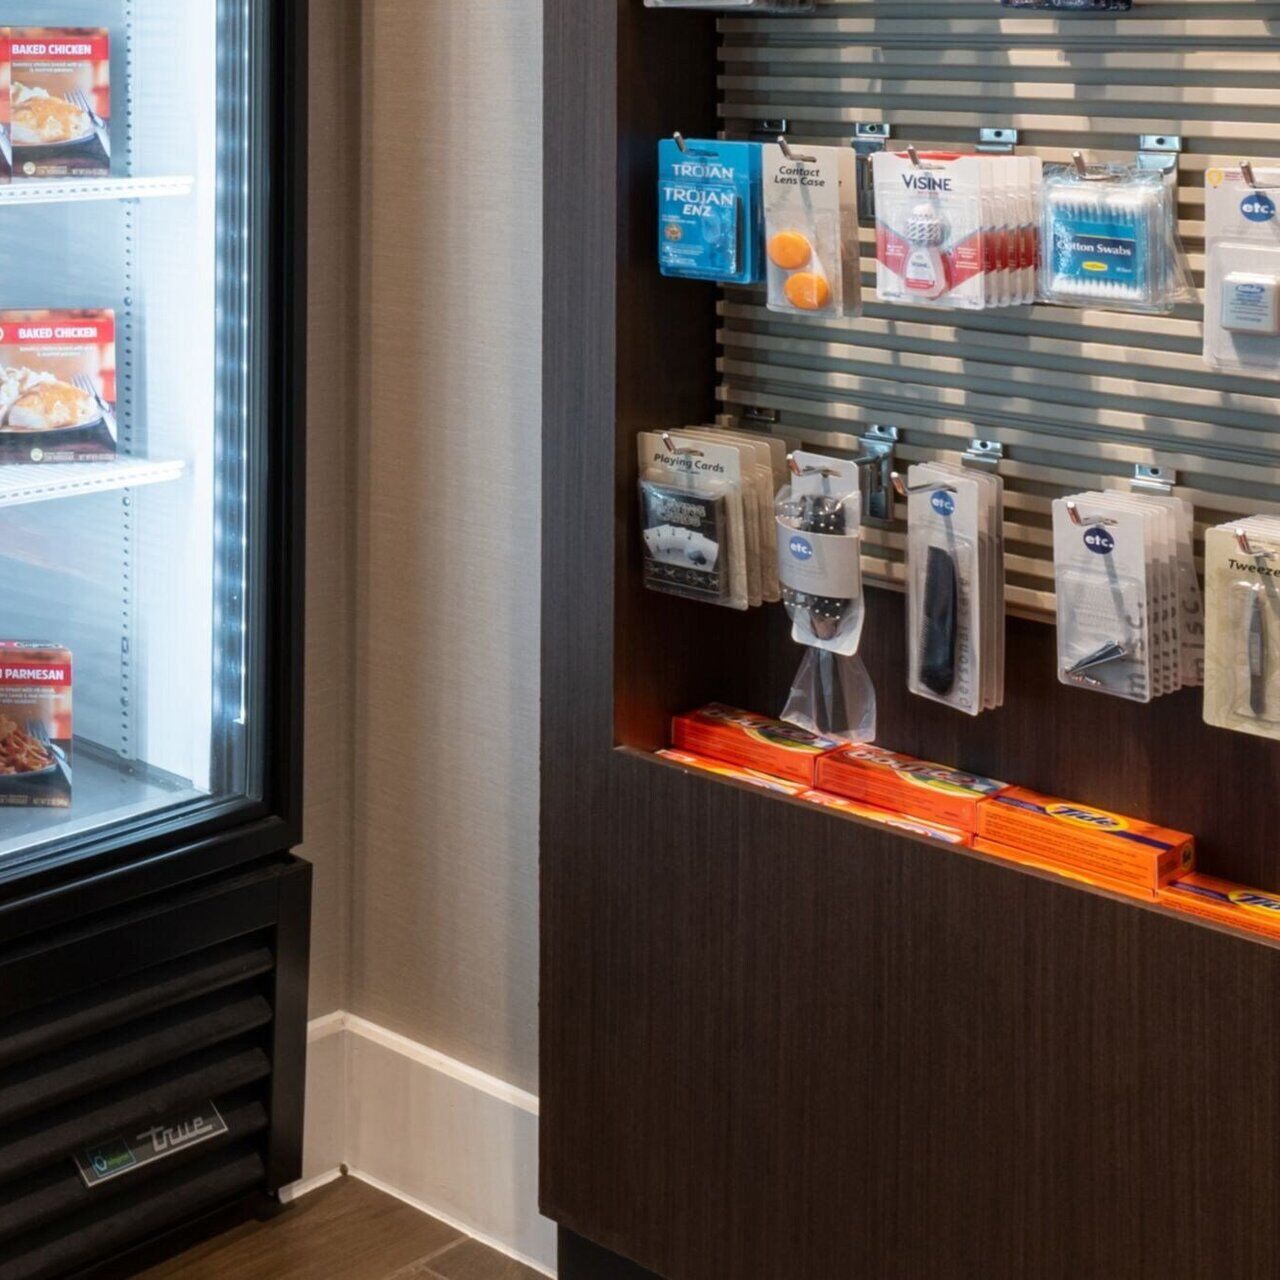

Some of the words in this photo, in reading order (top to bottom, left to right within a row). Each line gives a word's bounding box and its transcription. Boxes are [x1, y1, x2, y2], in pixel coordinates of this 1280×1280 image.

[12, 43, 46, 55] BAKED
[48, 43, 92, 55] CHICKEN
[672, 163, 734, 179] TROJAN
[778, 166, 820, 177] Contact
[774, 176, 798, 186] Lens
[800, 177, 825, 187] Case
[902, 174, 952, 192] VISINE
[663, 187, 735, 206] TROJAN
[682, 205, 713, 218] ENZ
[1242, 203, 1275, 215] etc.
[1057, 241, 1095, 253] Cotton
[1097, 243, 1132, 257] Swabs
[18, 327, 52, 339] BAKED
[54, 326, 97, 339] CHICKEN
[653, 453, 692, 469] Playing
[694, 460, 725, 473] Cards
[1085, 535, 1114, 548] etc.
[791, 543, 812, 556] etc.
[1229, 558, 1280, 577] Tweeze
[5, 668, 64, 681] PARMESAN
[1057, 806, 1120, 828] Tide
